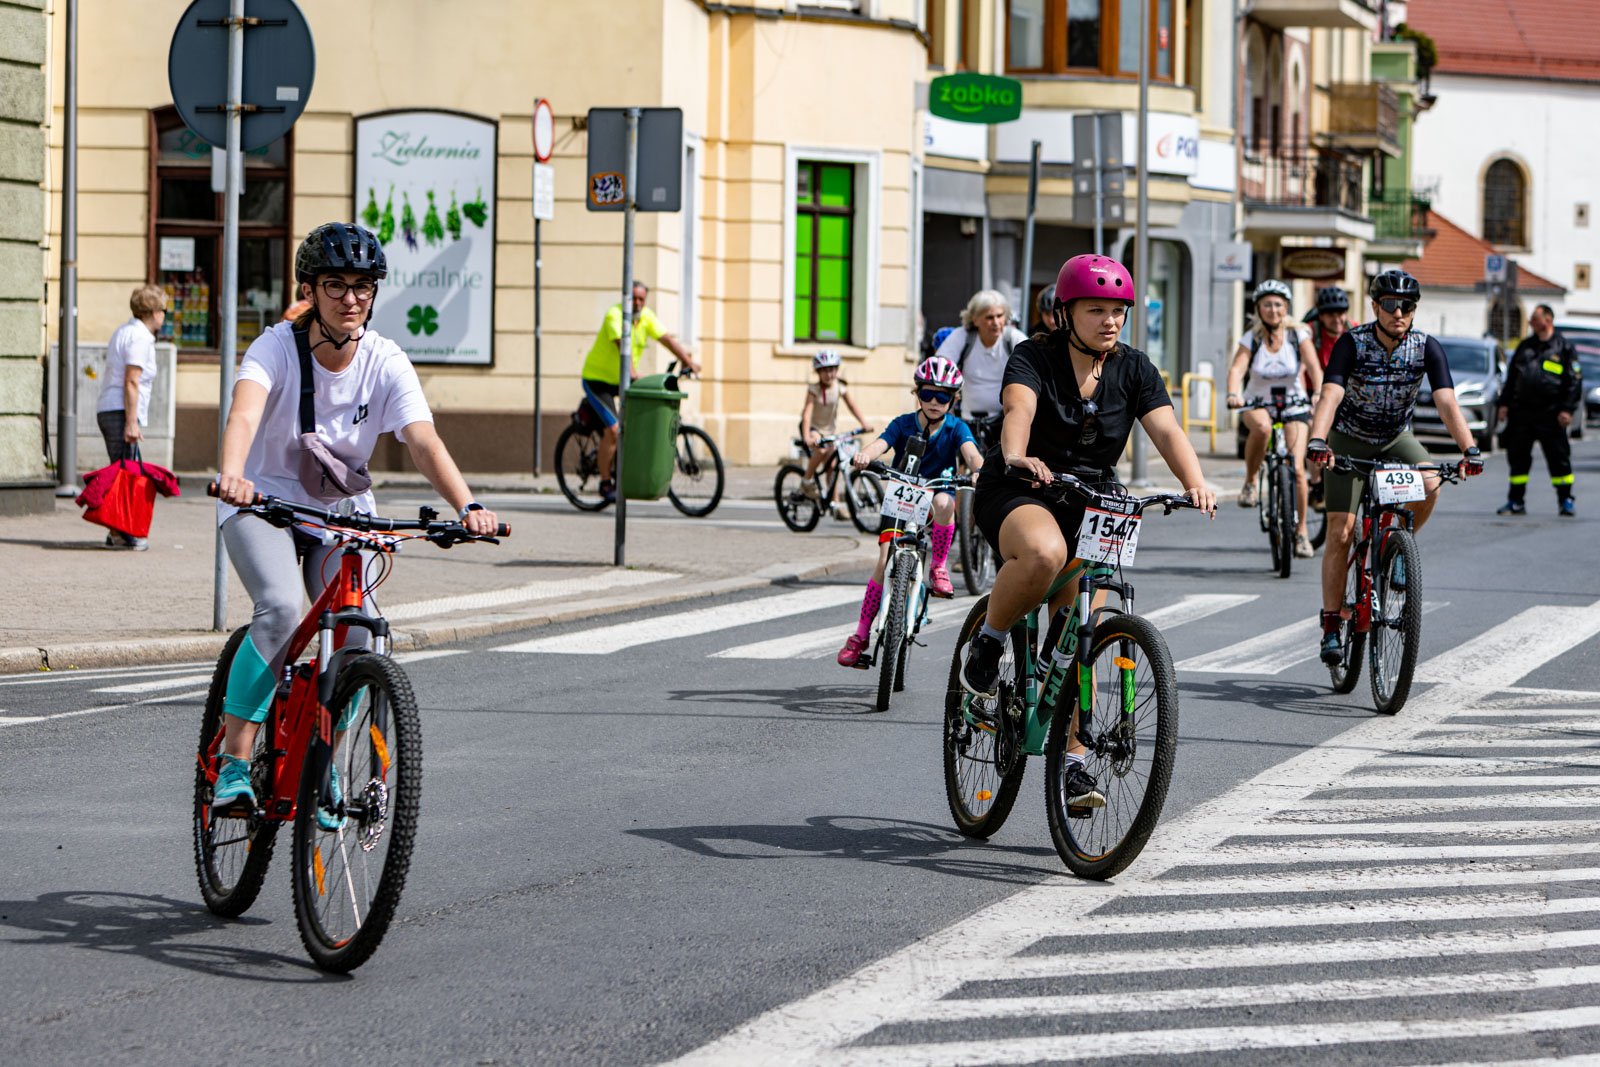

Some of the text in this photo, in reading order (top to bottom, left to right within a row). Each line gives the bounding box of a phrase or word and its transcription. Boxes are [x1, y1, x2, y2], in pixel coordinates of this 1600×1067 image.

[940, 81, 1015, 107] żabka
[371, 130, 481, 166] Zielarnia
[1385, 472, 1415, 485] 439
[893, 485, 926, 505] 437
[1088, 514, 1138, 541] 1547
